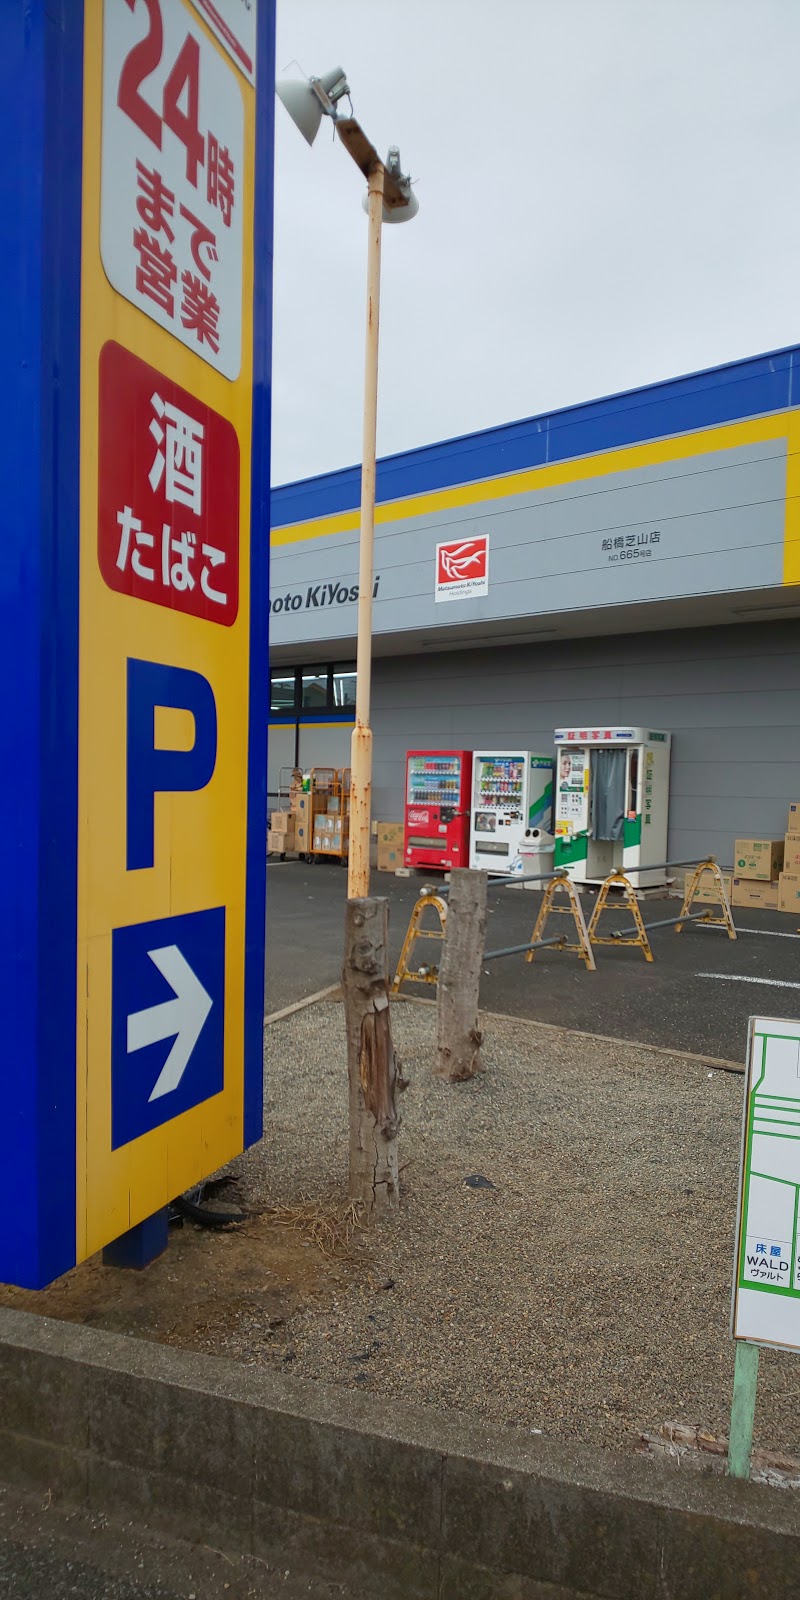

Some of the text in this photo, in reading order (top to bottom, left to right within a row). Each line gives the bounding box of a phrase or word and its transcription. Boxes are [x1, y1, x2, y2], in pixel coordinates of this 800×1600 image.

[117, 0, 235, 228] 24時
[135, 157, 219, 282] まで
[133, 226, 220, 355] 営業
[148, 391, 204, 517] 酒
[116, 504, 227, 605] たばこ
[601, 530, 661, 551] 船橋芝山店
[305, 575, 380, 609] KiYosi
[126, 656, 217, 871] P
[747, 1255, 788, 1271] WALD
[751, 1269, 783, 1281] ヴァルト
[756, 1243, 781, 1257] 床屋
